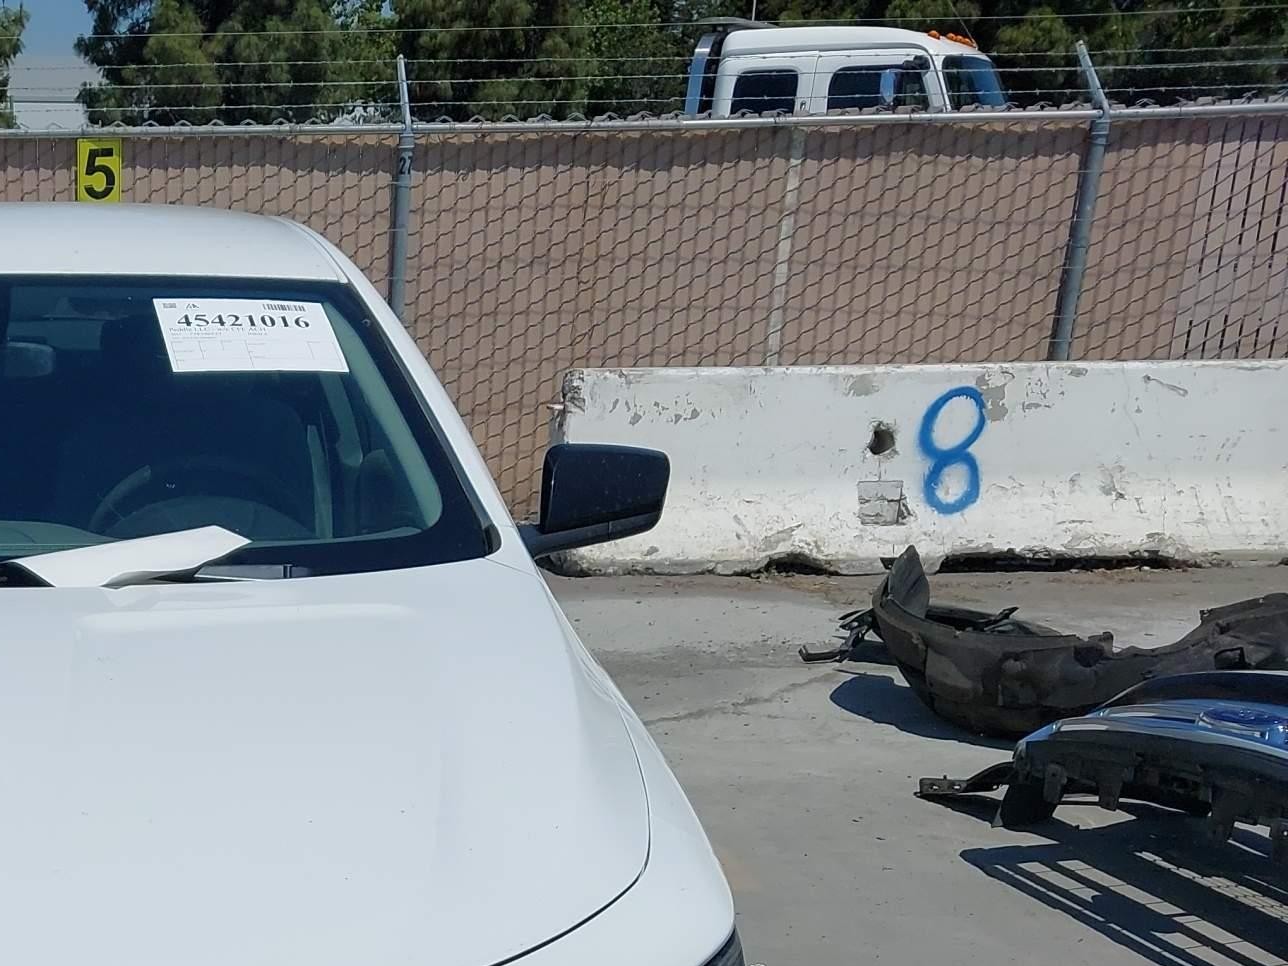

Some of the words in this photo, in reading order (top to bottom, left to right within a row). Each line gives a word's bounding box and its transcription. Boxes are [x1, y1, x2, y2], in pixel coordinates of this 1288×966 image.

[83, 147, 116, 200] 5
[177, 314, 310, 328] 45421016
[918, 385, 987, 516] 8
